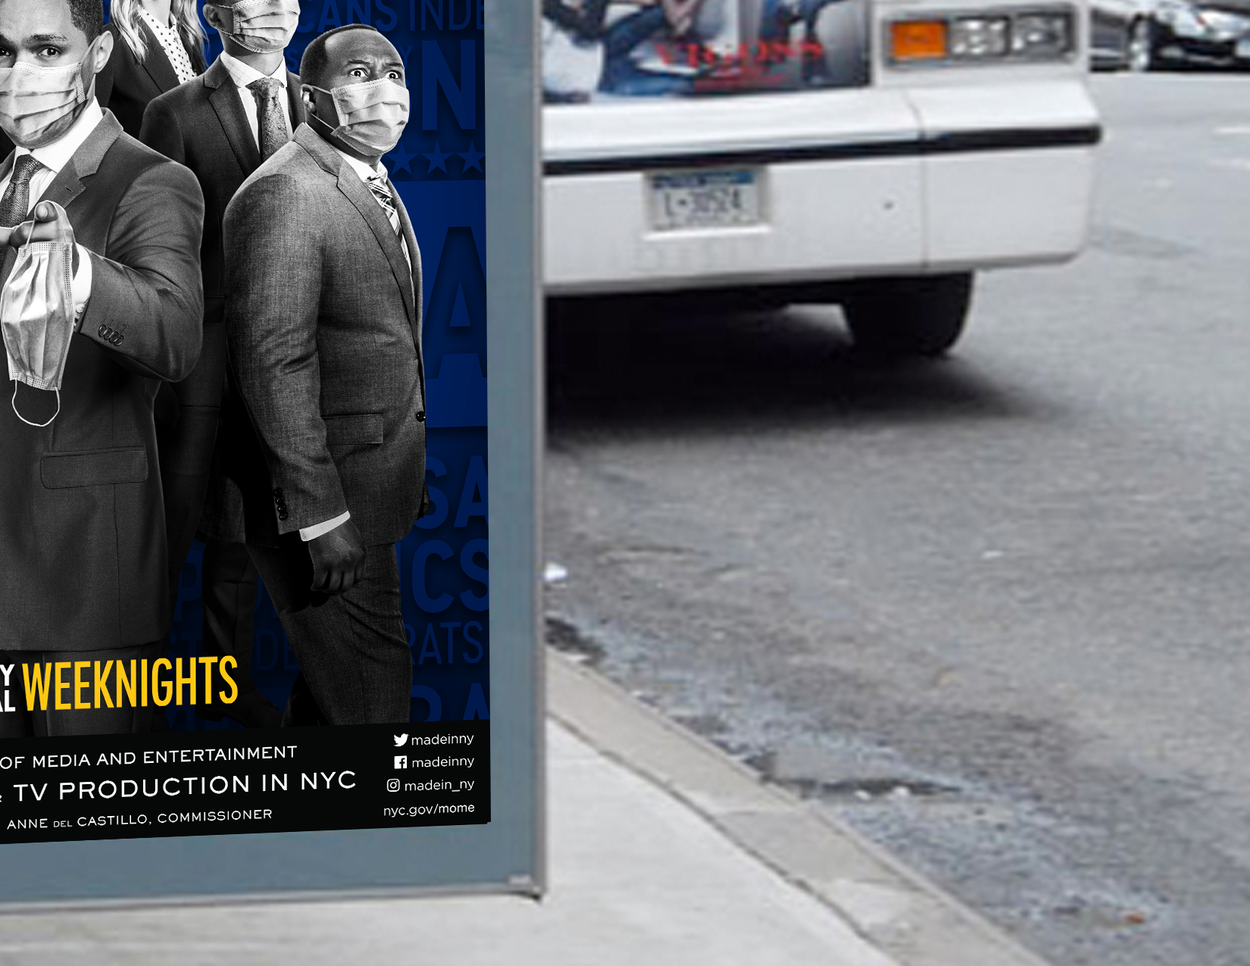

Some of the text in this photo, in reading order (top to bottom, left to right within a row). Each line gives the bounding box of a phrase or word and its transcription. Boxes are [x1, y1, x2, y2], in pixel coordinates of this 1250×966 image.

[22, 656, 238, 711] WEEKNIGHTS
[412, 734, 474, 745] madeinny
[0, 757, 25, 769] OF
[33, 754, 90, 768] MEDIA
[97, 752, 136, 765] AND
[144, 746, 297, 763] ENTERTAINMENT
[413, 756, 474, 768] madeinny
[13, 783, 47, 801] TV
[60, 775, 248, 800] PRODUCTION
[263, 774, 287, 791] IN
[302, 771, 355, 790] NYC
[405, 780, 474, 792] madein_ny
[384, 804, 474, 817] nyc.gov/mome
[7, 819, 47, 829] ANNE
[77, 814, 151, 826] CASTILLO,
[158, 809, 272, 823] COMMISSIONER
